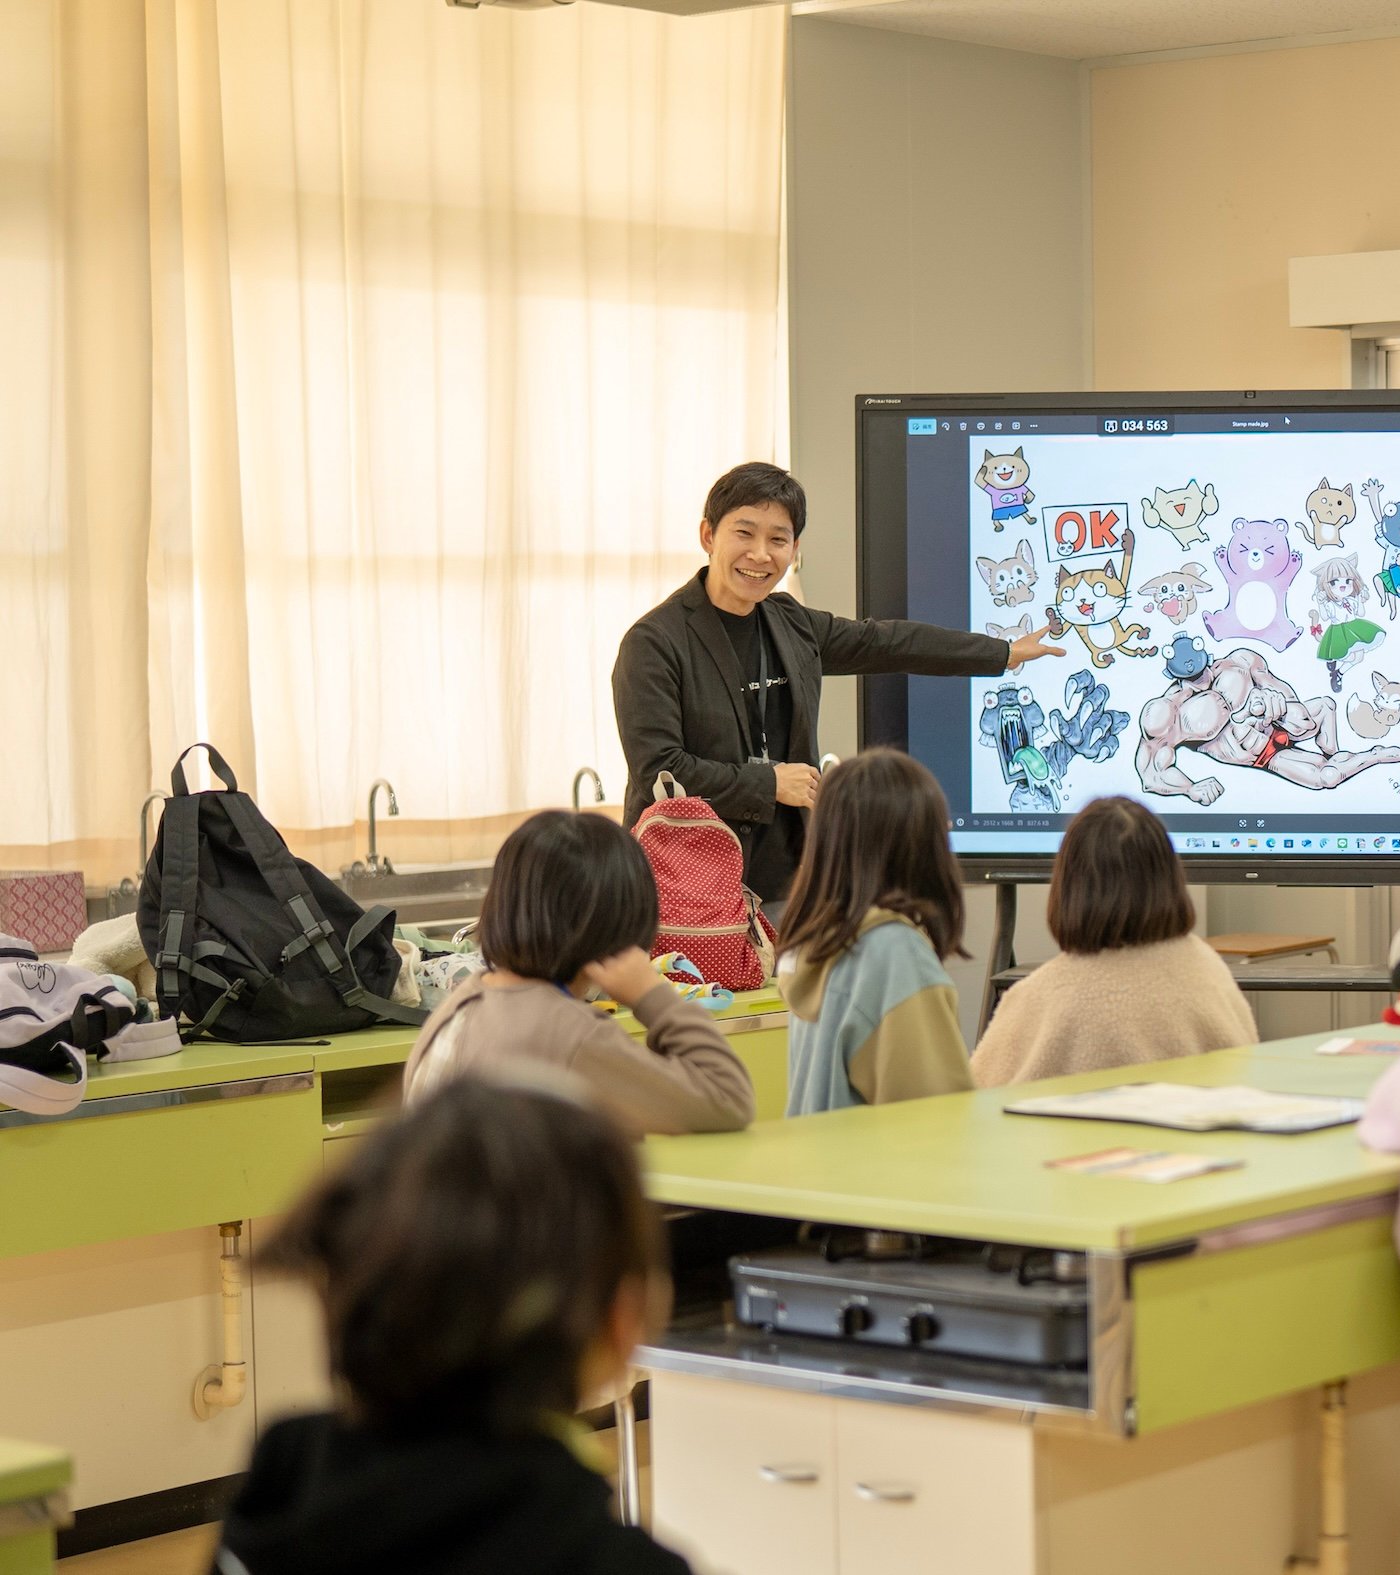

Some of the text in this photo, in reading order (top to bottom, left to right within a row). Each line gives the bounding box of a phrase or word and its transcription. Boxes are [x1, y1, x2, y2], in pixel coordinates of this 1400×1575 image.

[1121, 419, 1168, 432] 034 563
[1232, 420, 1247, 428] Stamp
[1055, 509, 1120, 551] OK
